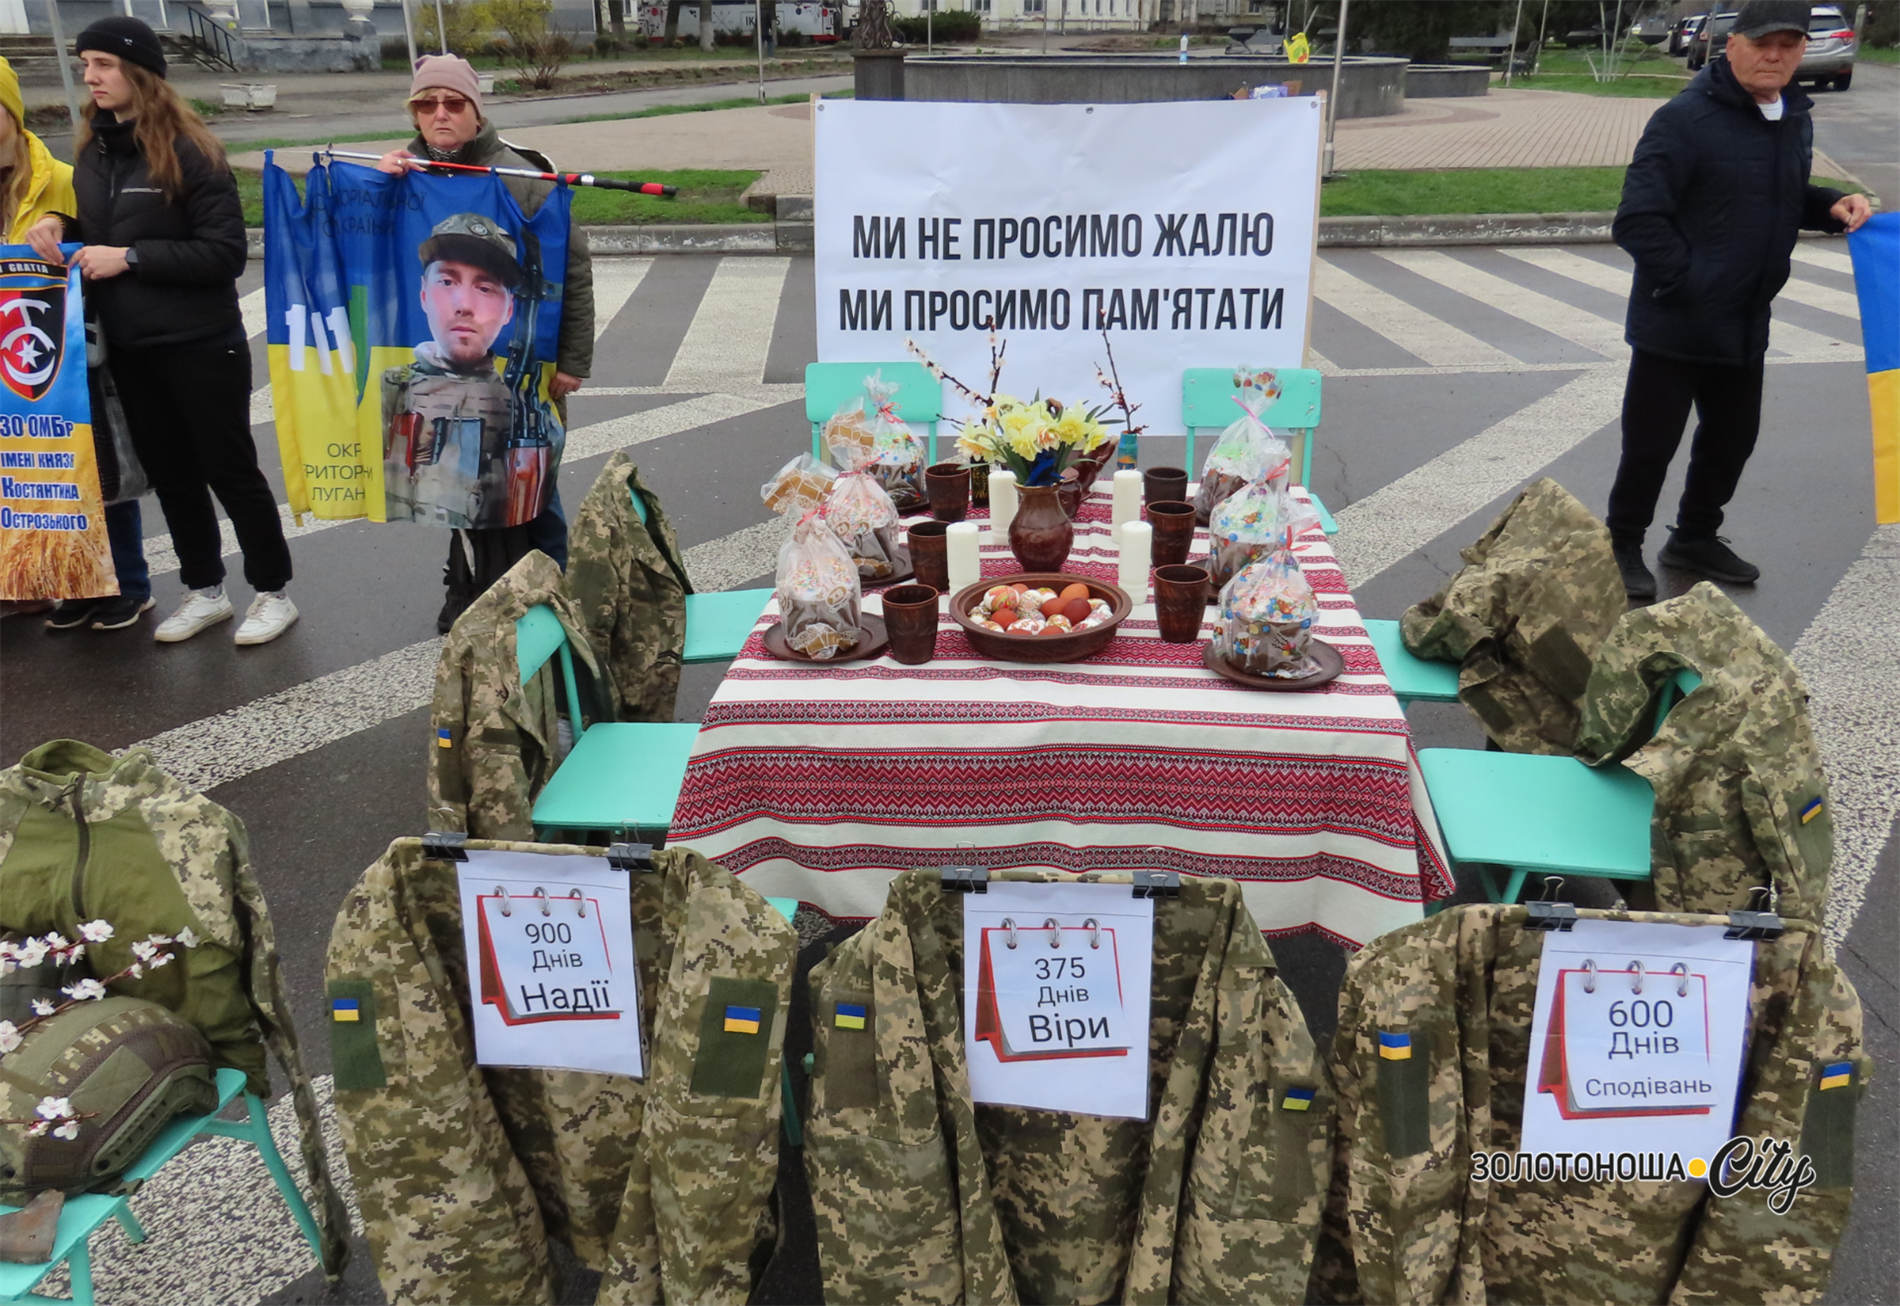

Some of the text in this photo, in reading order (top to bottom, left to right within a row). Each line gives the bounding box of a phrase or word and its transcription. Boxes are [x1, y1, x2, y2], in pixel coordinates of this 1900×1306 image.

[853, 212, 1275, 260] МИ НЕ ПРОСИМО ЖАЛЮ
[8, 262, 49, 274] GRATIA
[839, 287, 1285, 331] МИ ПРОСИМО ПАМ'ЯТАТИ
[0, 415, 24, 438] 30
[0, 452, 35, 468] ІМЕНІ
[524, 922, 572, 945] 900
[532, 949, 584, 973] Днів
[1034, 957, 1086, 980] 375
[520, 980, 611, 1014] Надії
[1037, 984, 1090, 1008] Днів
[1608, 999, 1674, 1028] 600
[1028, 1013, 1111, 1048] Віри
[1608, 1031, 1680, 1060] Днів
[1585, 1077, 1713, 1099] Сподівань
